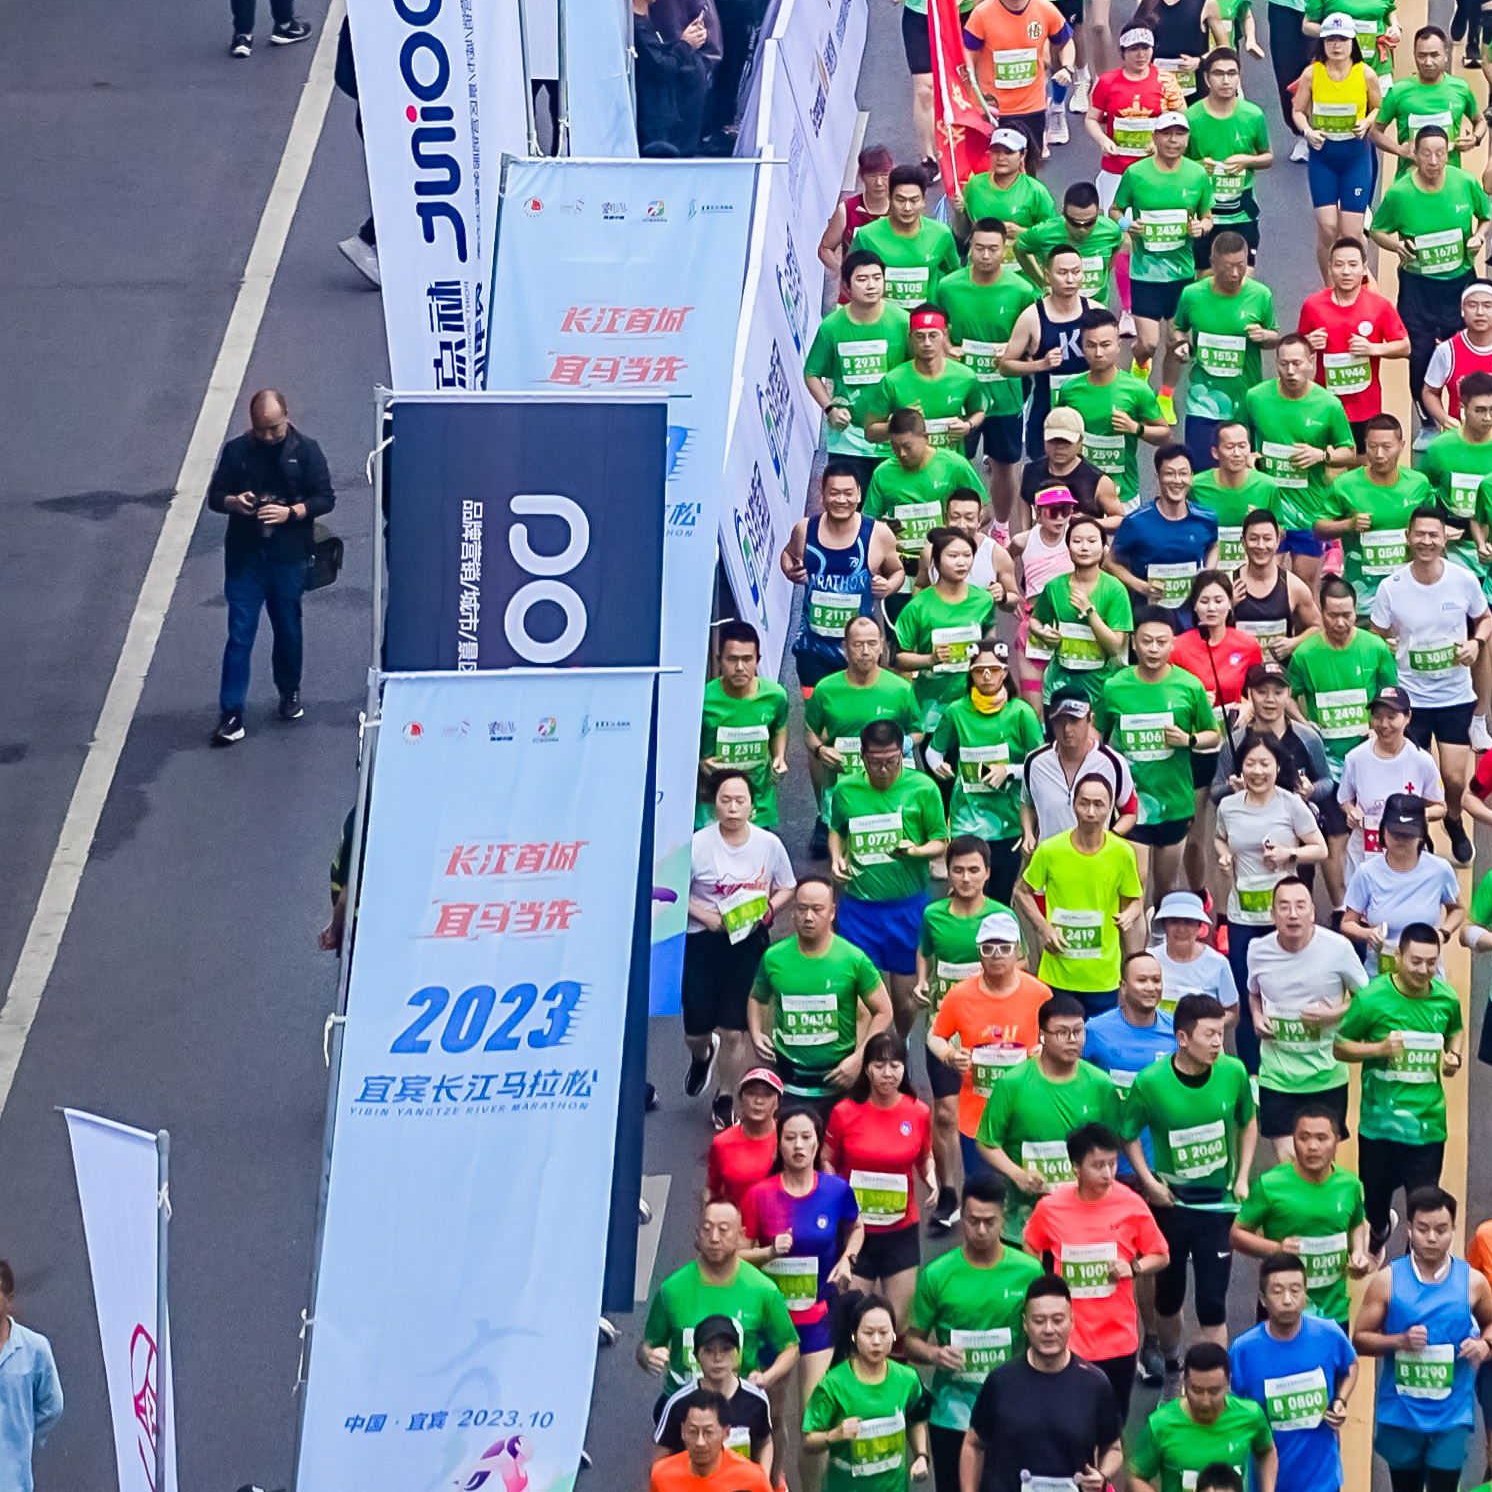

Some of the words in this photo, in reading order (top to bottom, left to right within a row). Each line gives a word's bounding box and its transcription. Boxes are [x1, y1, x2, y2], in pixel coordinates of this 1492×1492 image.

[1026, 20, 1044, 40] 悟
[998, 65, 1006, 76] B
[1008, 63, 1033, 74] 2137
[1146, 226, 1153, 237] B
[1157, 224, 1183, 236] 2436
[885, 283, 893, 293] B
[896, 282, 923, 293] 3105
[560, 306, 696, 334] 长江首城
[549, 352, 688, 386] 宜马当先
[843, 357, 851, 368] B
[854, 355, 881, 368] 2931
[1328, 368, 1337, 380] B
[1339, 366, 1367, 379] 1946
[1092, 449, 1121, 462] 2599
[1165, 579, 1192, 592] 3091
[855, 834, 865, 847] B
[869, 831, 897, 847] 0773
[445, 840, 589, 877] 长江首城
[433, 899, 583, 940] 宜马当先
[1066, 929, 1096, 943] 2419
[389, 980, 592, 1054] 2023
[788, 1014, 796, 1025] B
[800, 1013, 833, 1026] 0434
[1407, 1052, 1436, 1065] 0444
[354, 1069, 598, 1103] 宜宾长江马拉松
[350, 1106, 389, 1117] YIBIN
[398, 1106, 460, 1117] YANGTZE
[466, 1104, 506, 1115] RIVER
[511, 1102, 590, 1113] MARATHON
[1178, 1148, 1187, 1160] B
[1192, 1140, 1223, 1158] 2060
[1041, 1161, 1072, 1174] 1610
[1313, 1255, 1342, 1270] 0201
[971, 1350, 1006, 1365] 0804
[1274, 1400, 1283, 1414] B
[1288, 1393, 1323, 1411] 0800
[457, 1408, 554, 1430] 2023.10
